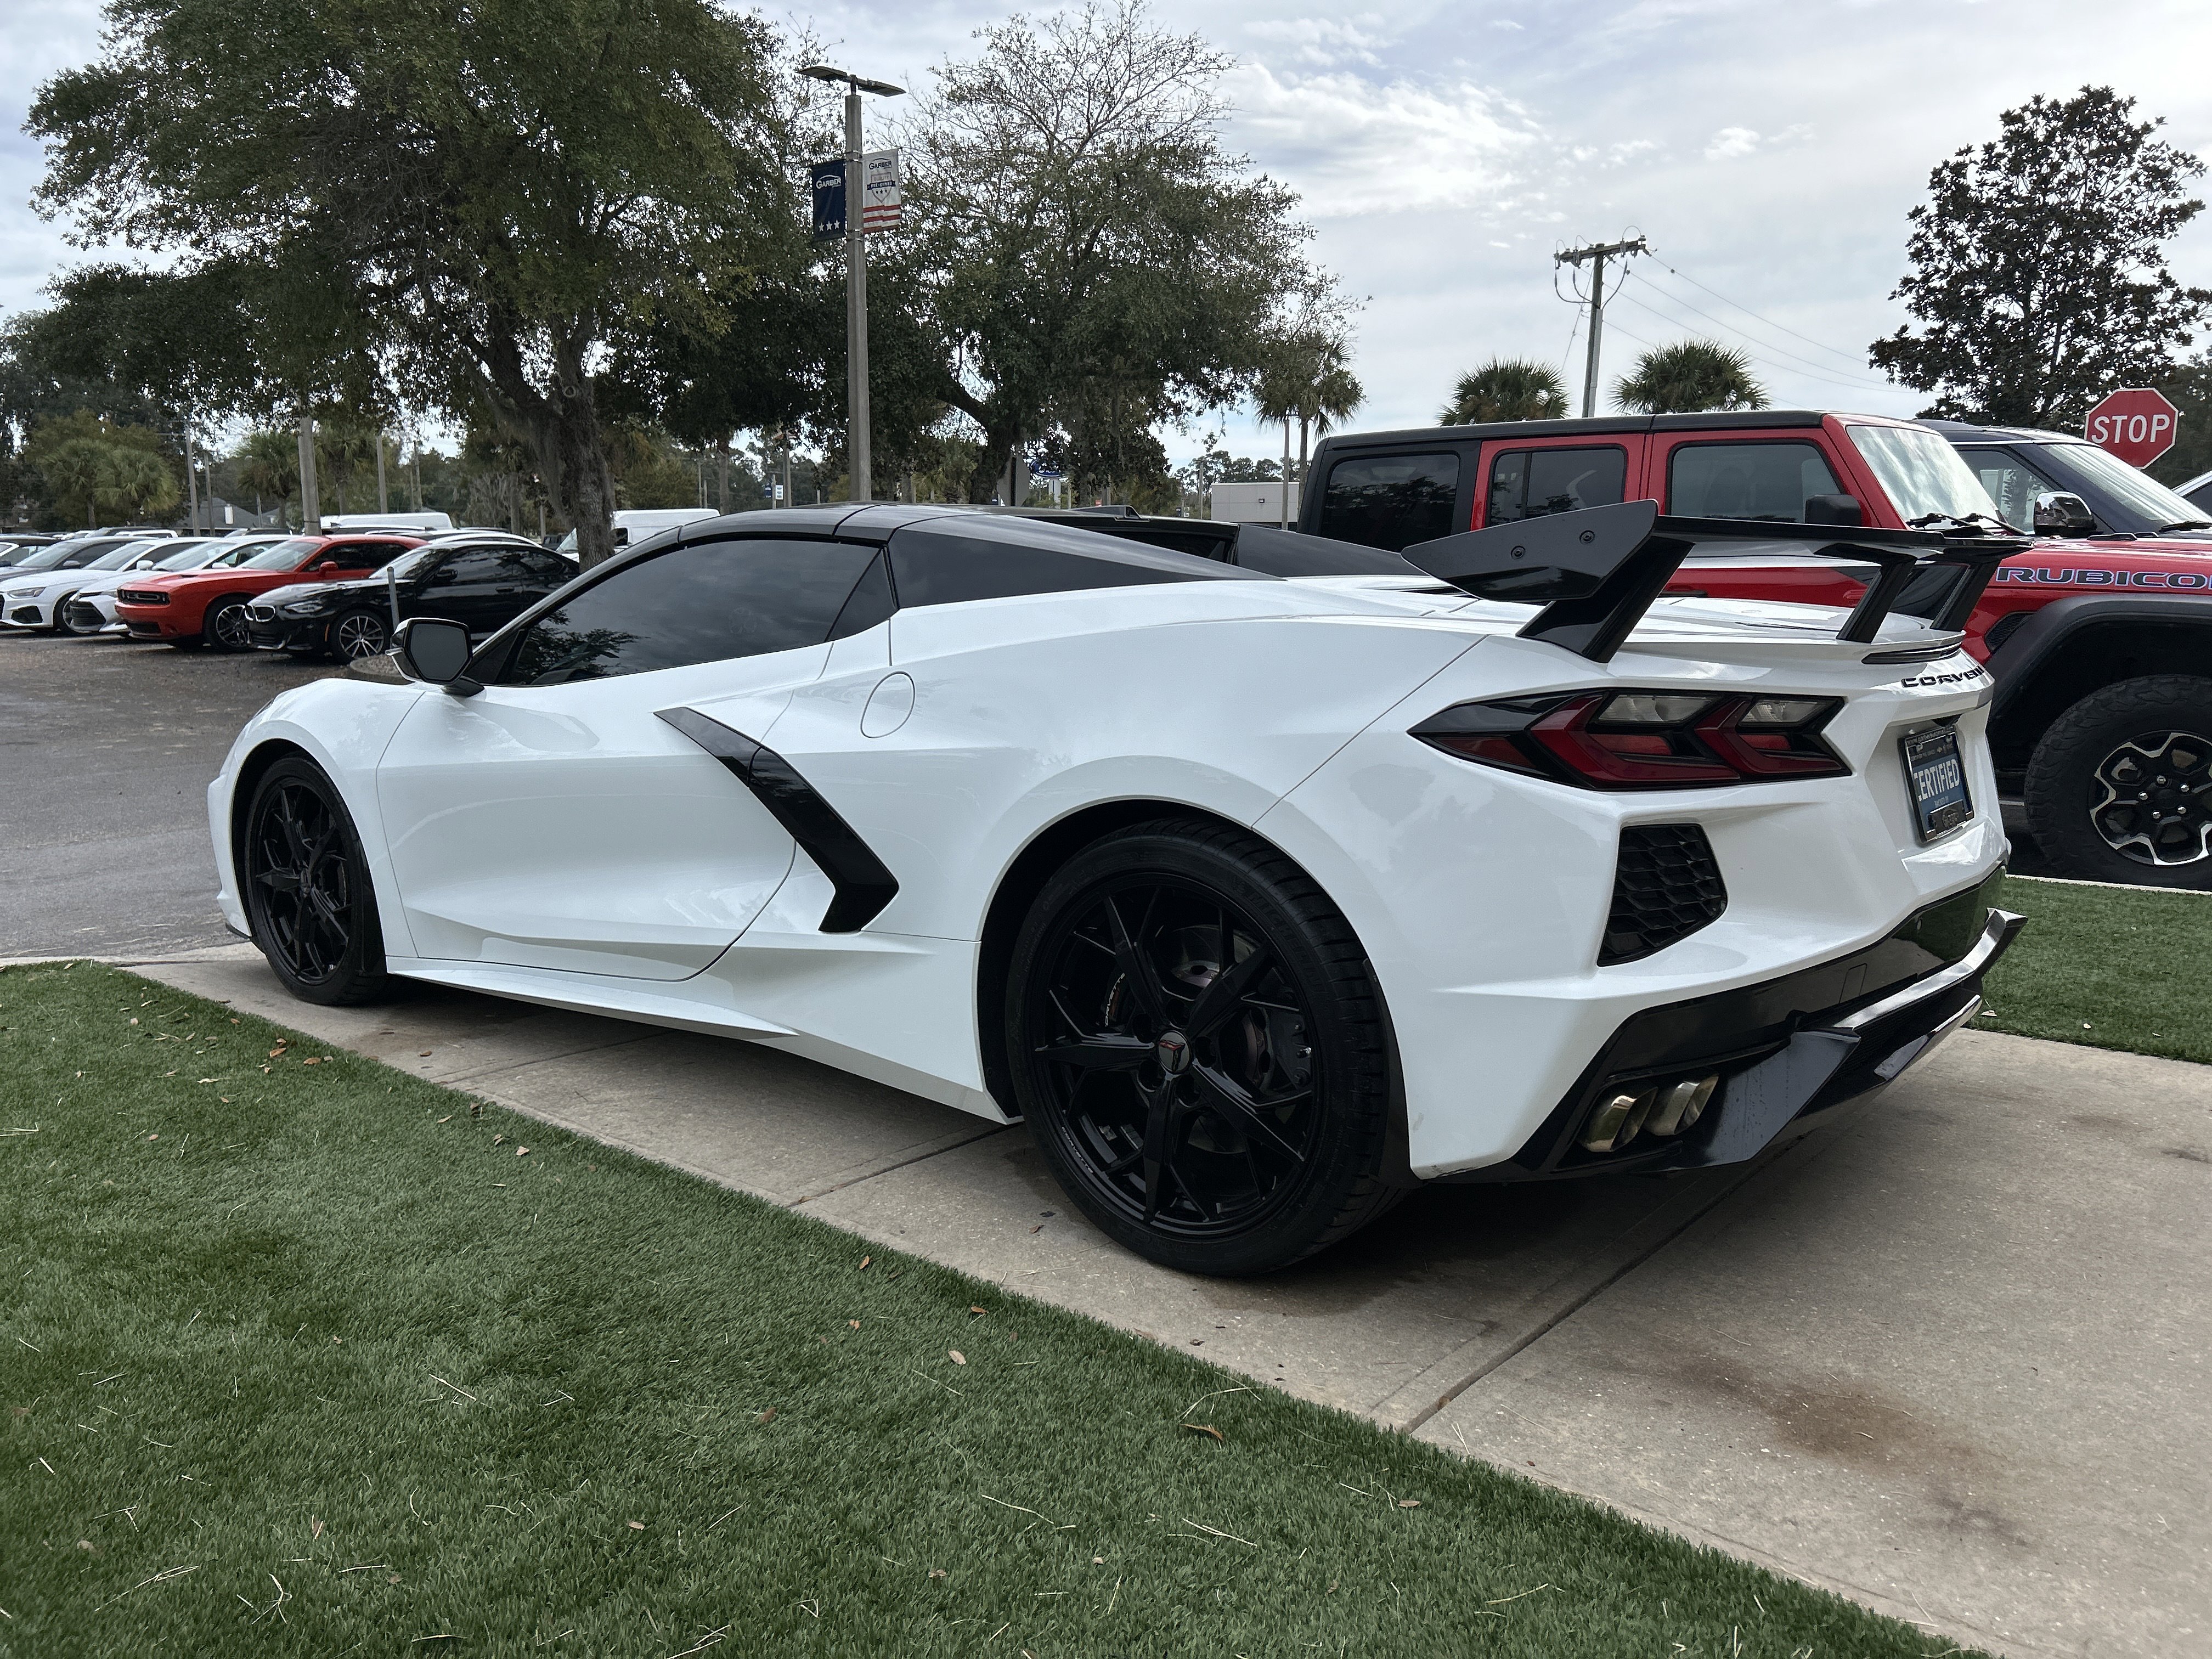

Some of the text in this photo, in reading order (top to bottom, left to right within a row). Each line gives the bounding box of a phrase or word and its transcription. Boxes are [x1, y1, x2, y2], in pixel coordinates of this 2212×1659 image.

[869, 161, 891, 170] GARBER
[816, 178, 841, 189] GARBER
[2091, 414, 2170, 444] STOP
[1995, 566, 2212, 589] RUBICO
[1105, 973, 1125, 1027] ORVETTE
